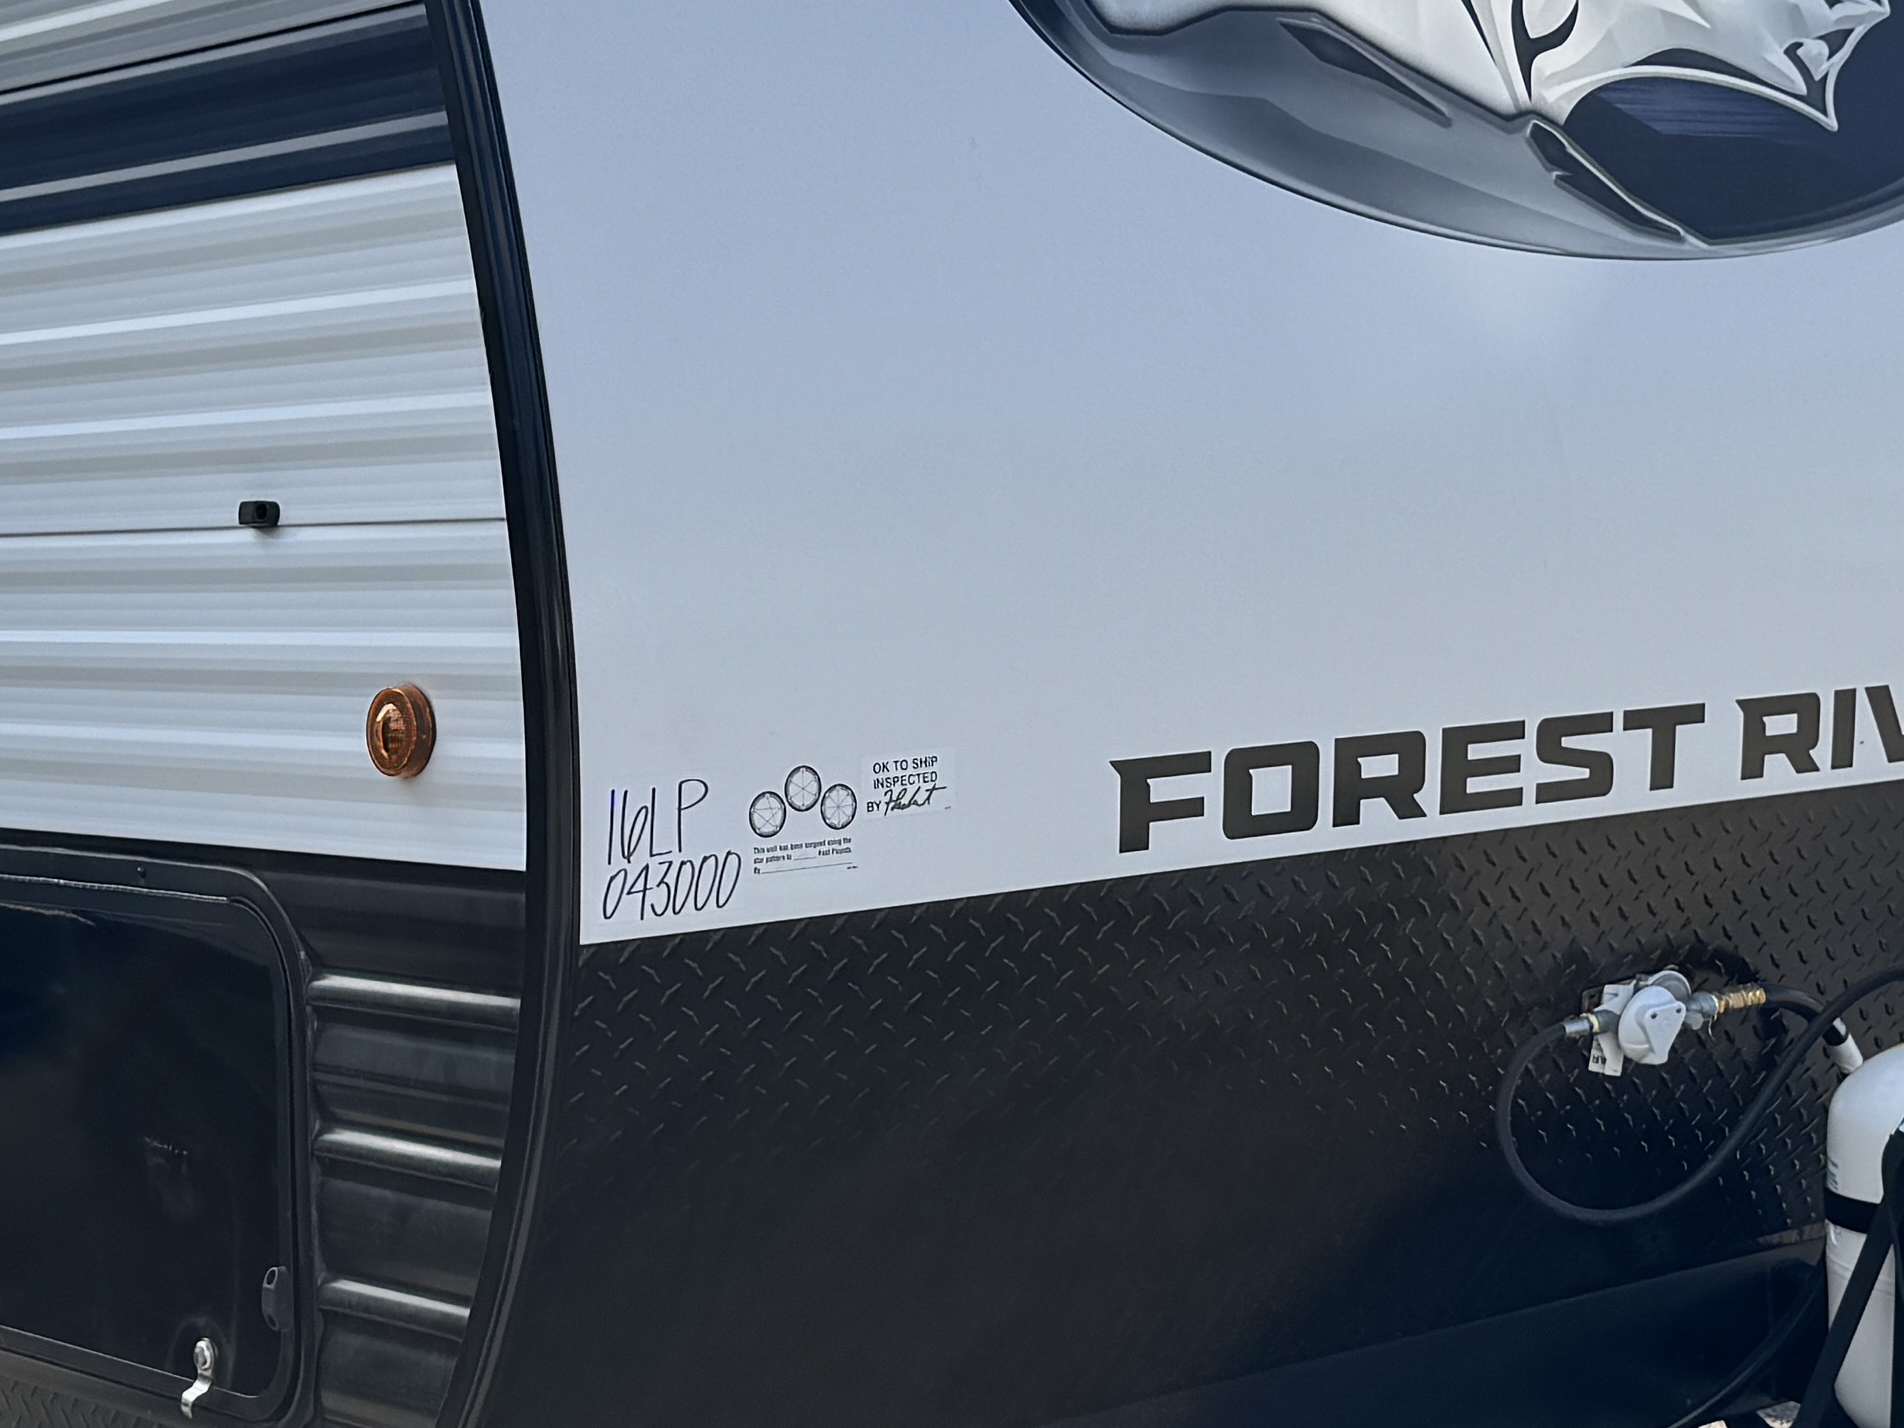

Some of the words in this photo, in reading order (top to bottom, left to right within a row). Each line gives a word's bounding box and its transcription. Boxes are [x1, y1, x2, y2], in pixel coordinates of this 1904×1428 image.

[872, 761, 890, 774] OK
[893, 759, 908, 771] TO
[912, 755, 938, 769] SHIP
[873, 771, 938, 789] INSPECTED
[1109, 702, 1706, 854] FOREST
[866, 800, 881, 812] BY
[602, 850, 742, 920] 043000
